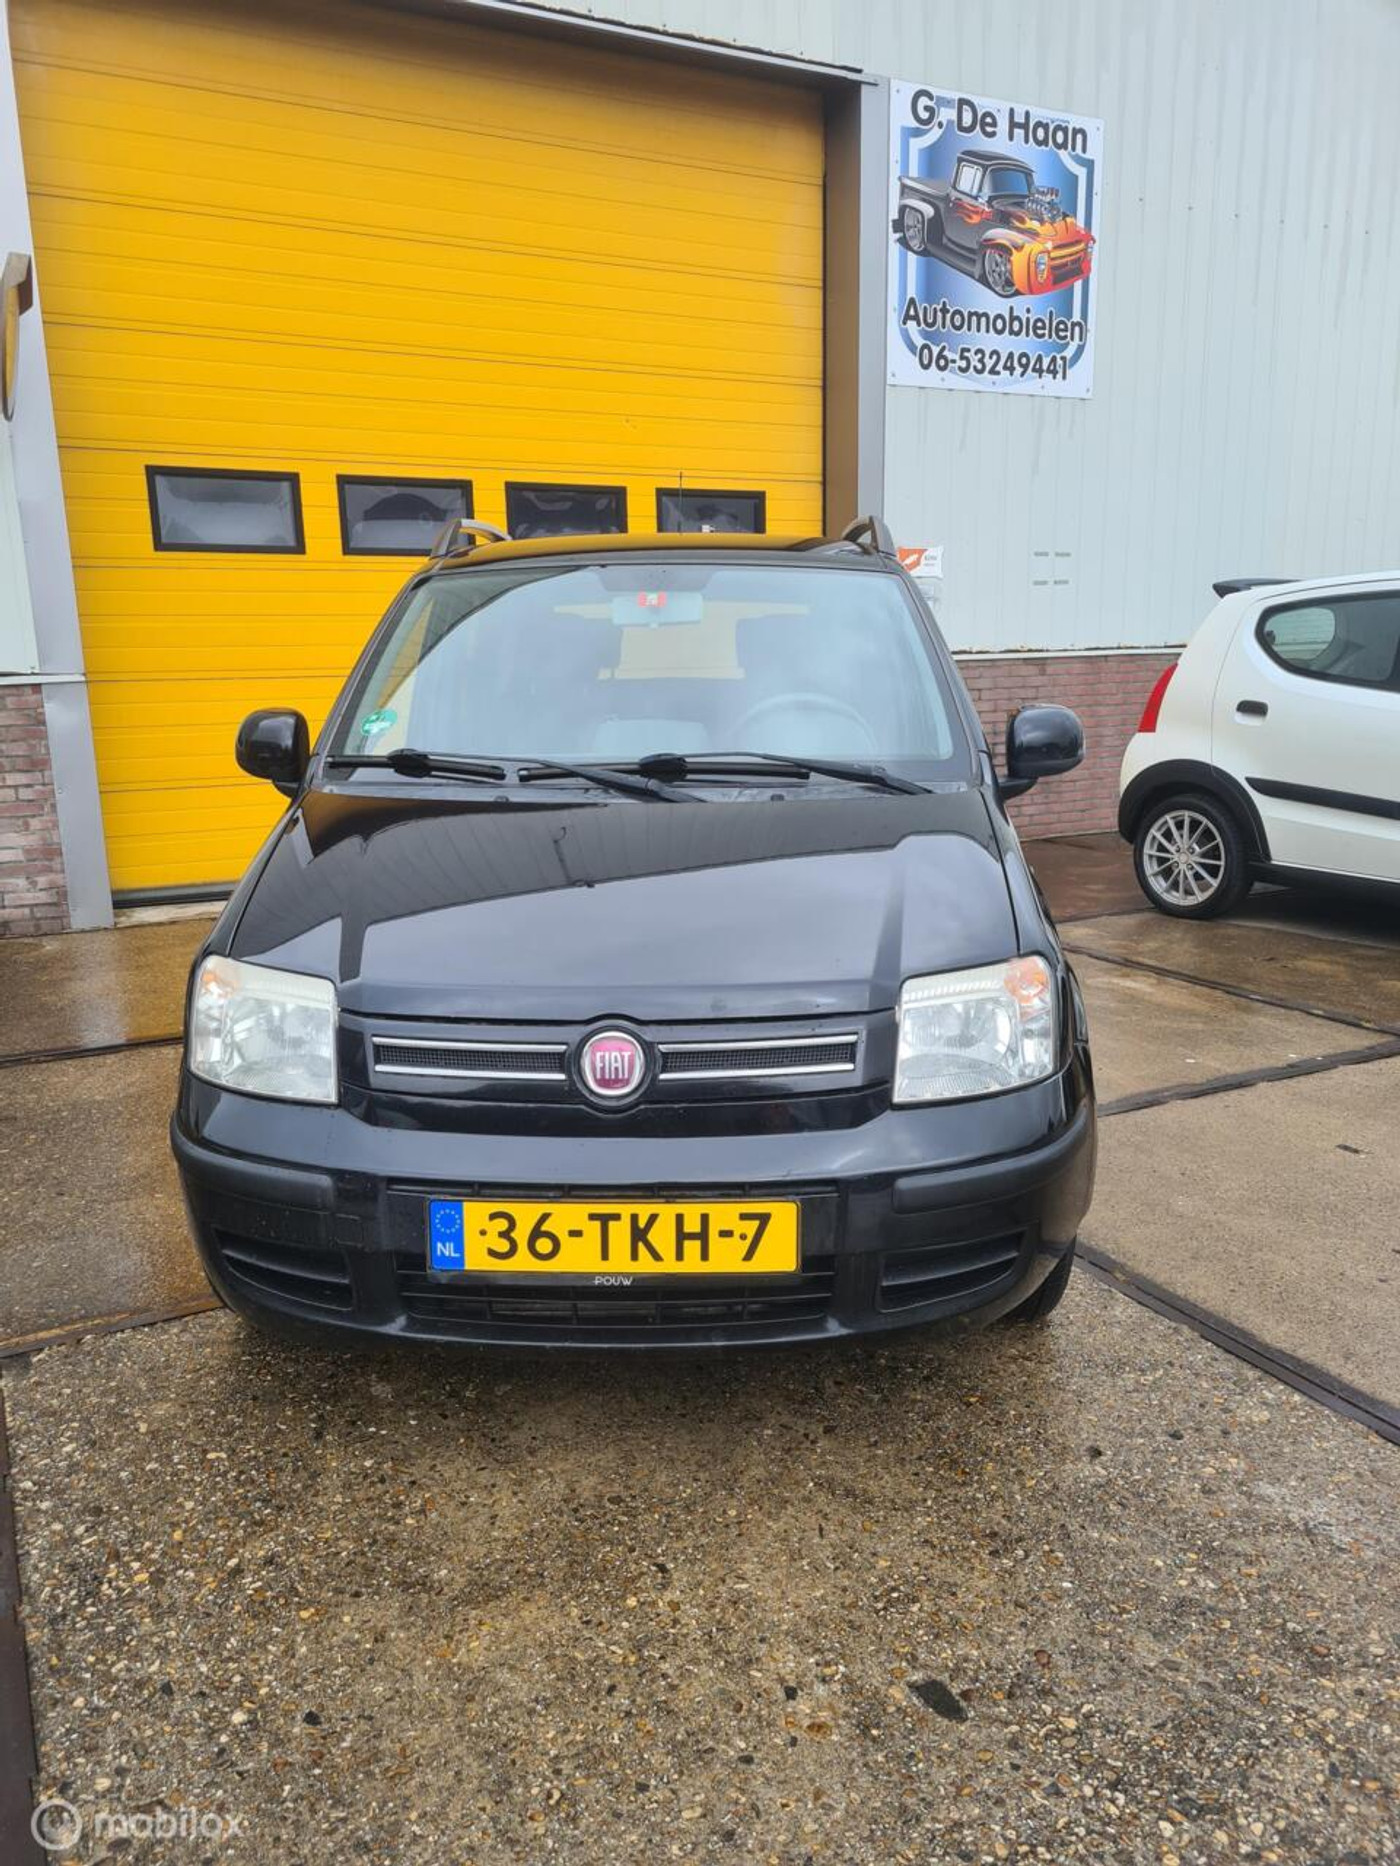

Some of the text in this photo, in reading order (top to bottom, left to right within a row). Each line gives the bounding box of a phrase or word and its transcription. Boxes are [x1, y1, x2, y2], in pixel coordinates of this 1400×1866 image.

[911, 89, 1088, 154] G. De Haan
[902, 297, 1084, 342] Automobielen
[918, 343, 1068, 380] 06-53249441
[595, 1051, 631, 1079] FIAT
[437, 1242, 460, 1257] NL
[486, 1211, 772, 1262] 36-TKH-7
[594, 1276, 633, 1286] POUW
